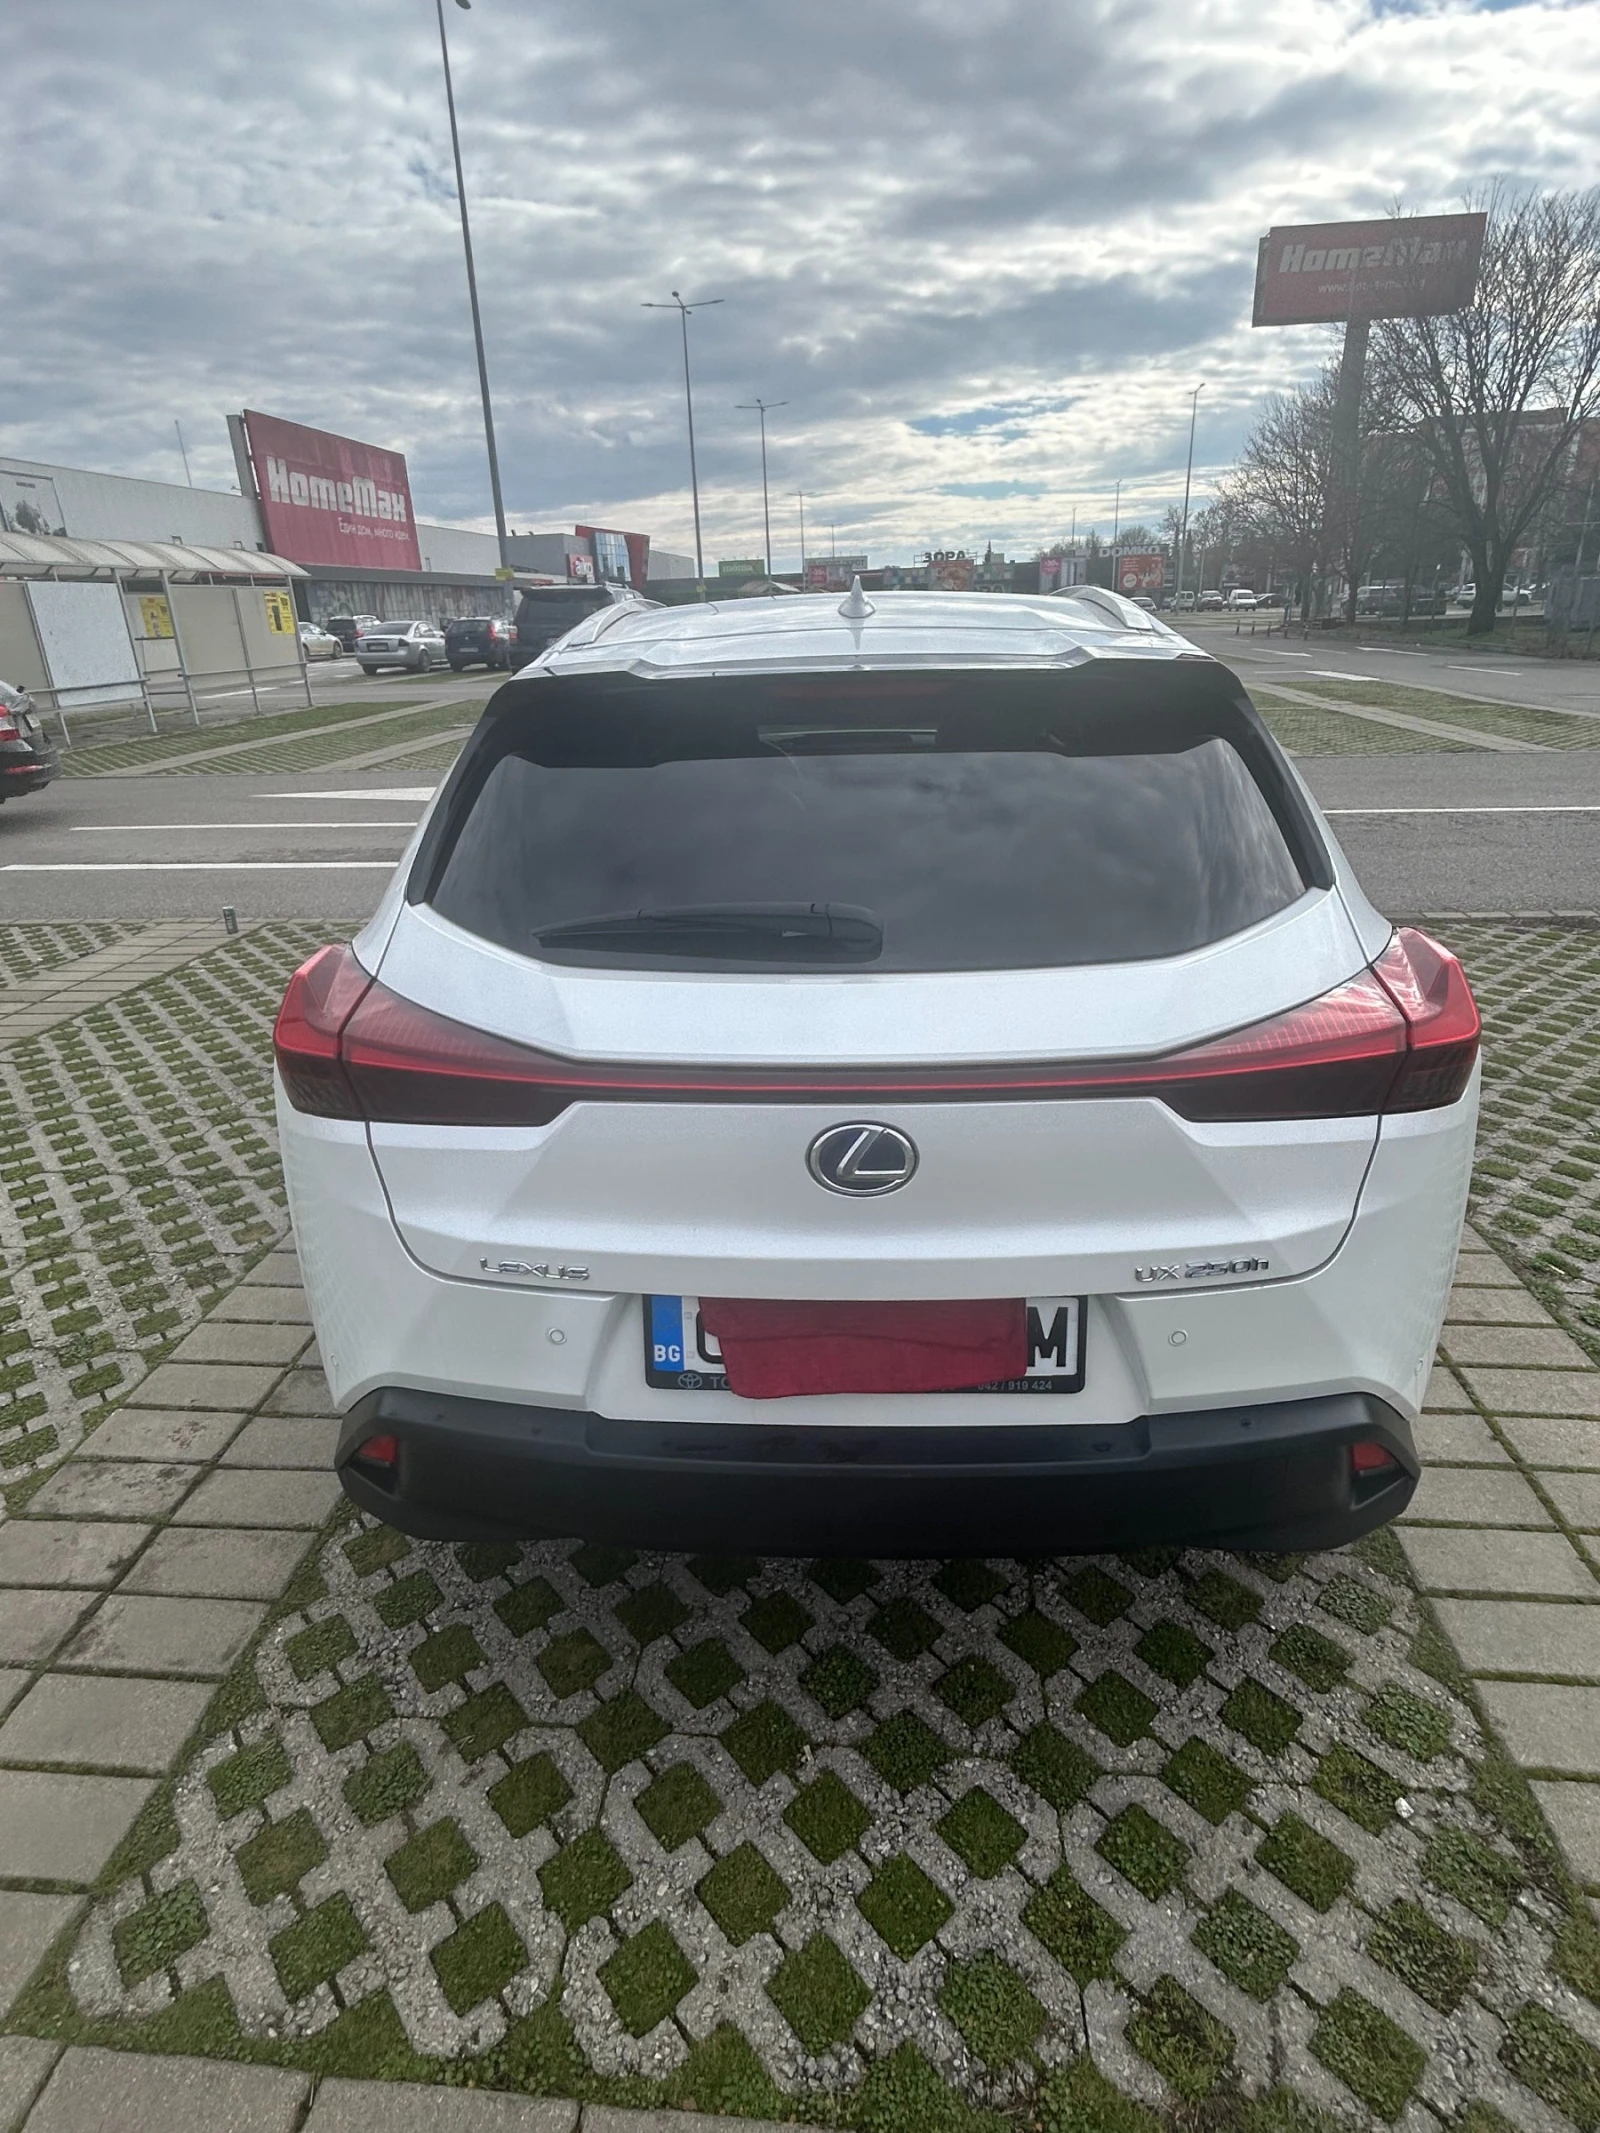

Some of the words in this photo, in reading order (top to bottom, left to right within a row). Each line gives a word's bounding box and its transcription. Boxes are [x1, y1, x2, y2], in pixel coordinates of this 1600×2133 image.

[266, 456, 407, 522] HomeMax
[922, 550, 966, 563] ЗОРА
[1099, 545, 1161, 558] DOMKO
[480, 1258, 590, 1280] LEXUS
[1135, 1264, 1181, 1282] UX
[1184, 1256, 1270, 1278] 250h
[653, 1344, 681, 1362] BG
[1008, 1380, 1029, 1391] 919
[1031, 1380, 1053, 1391] 424
